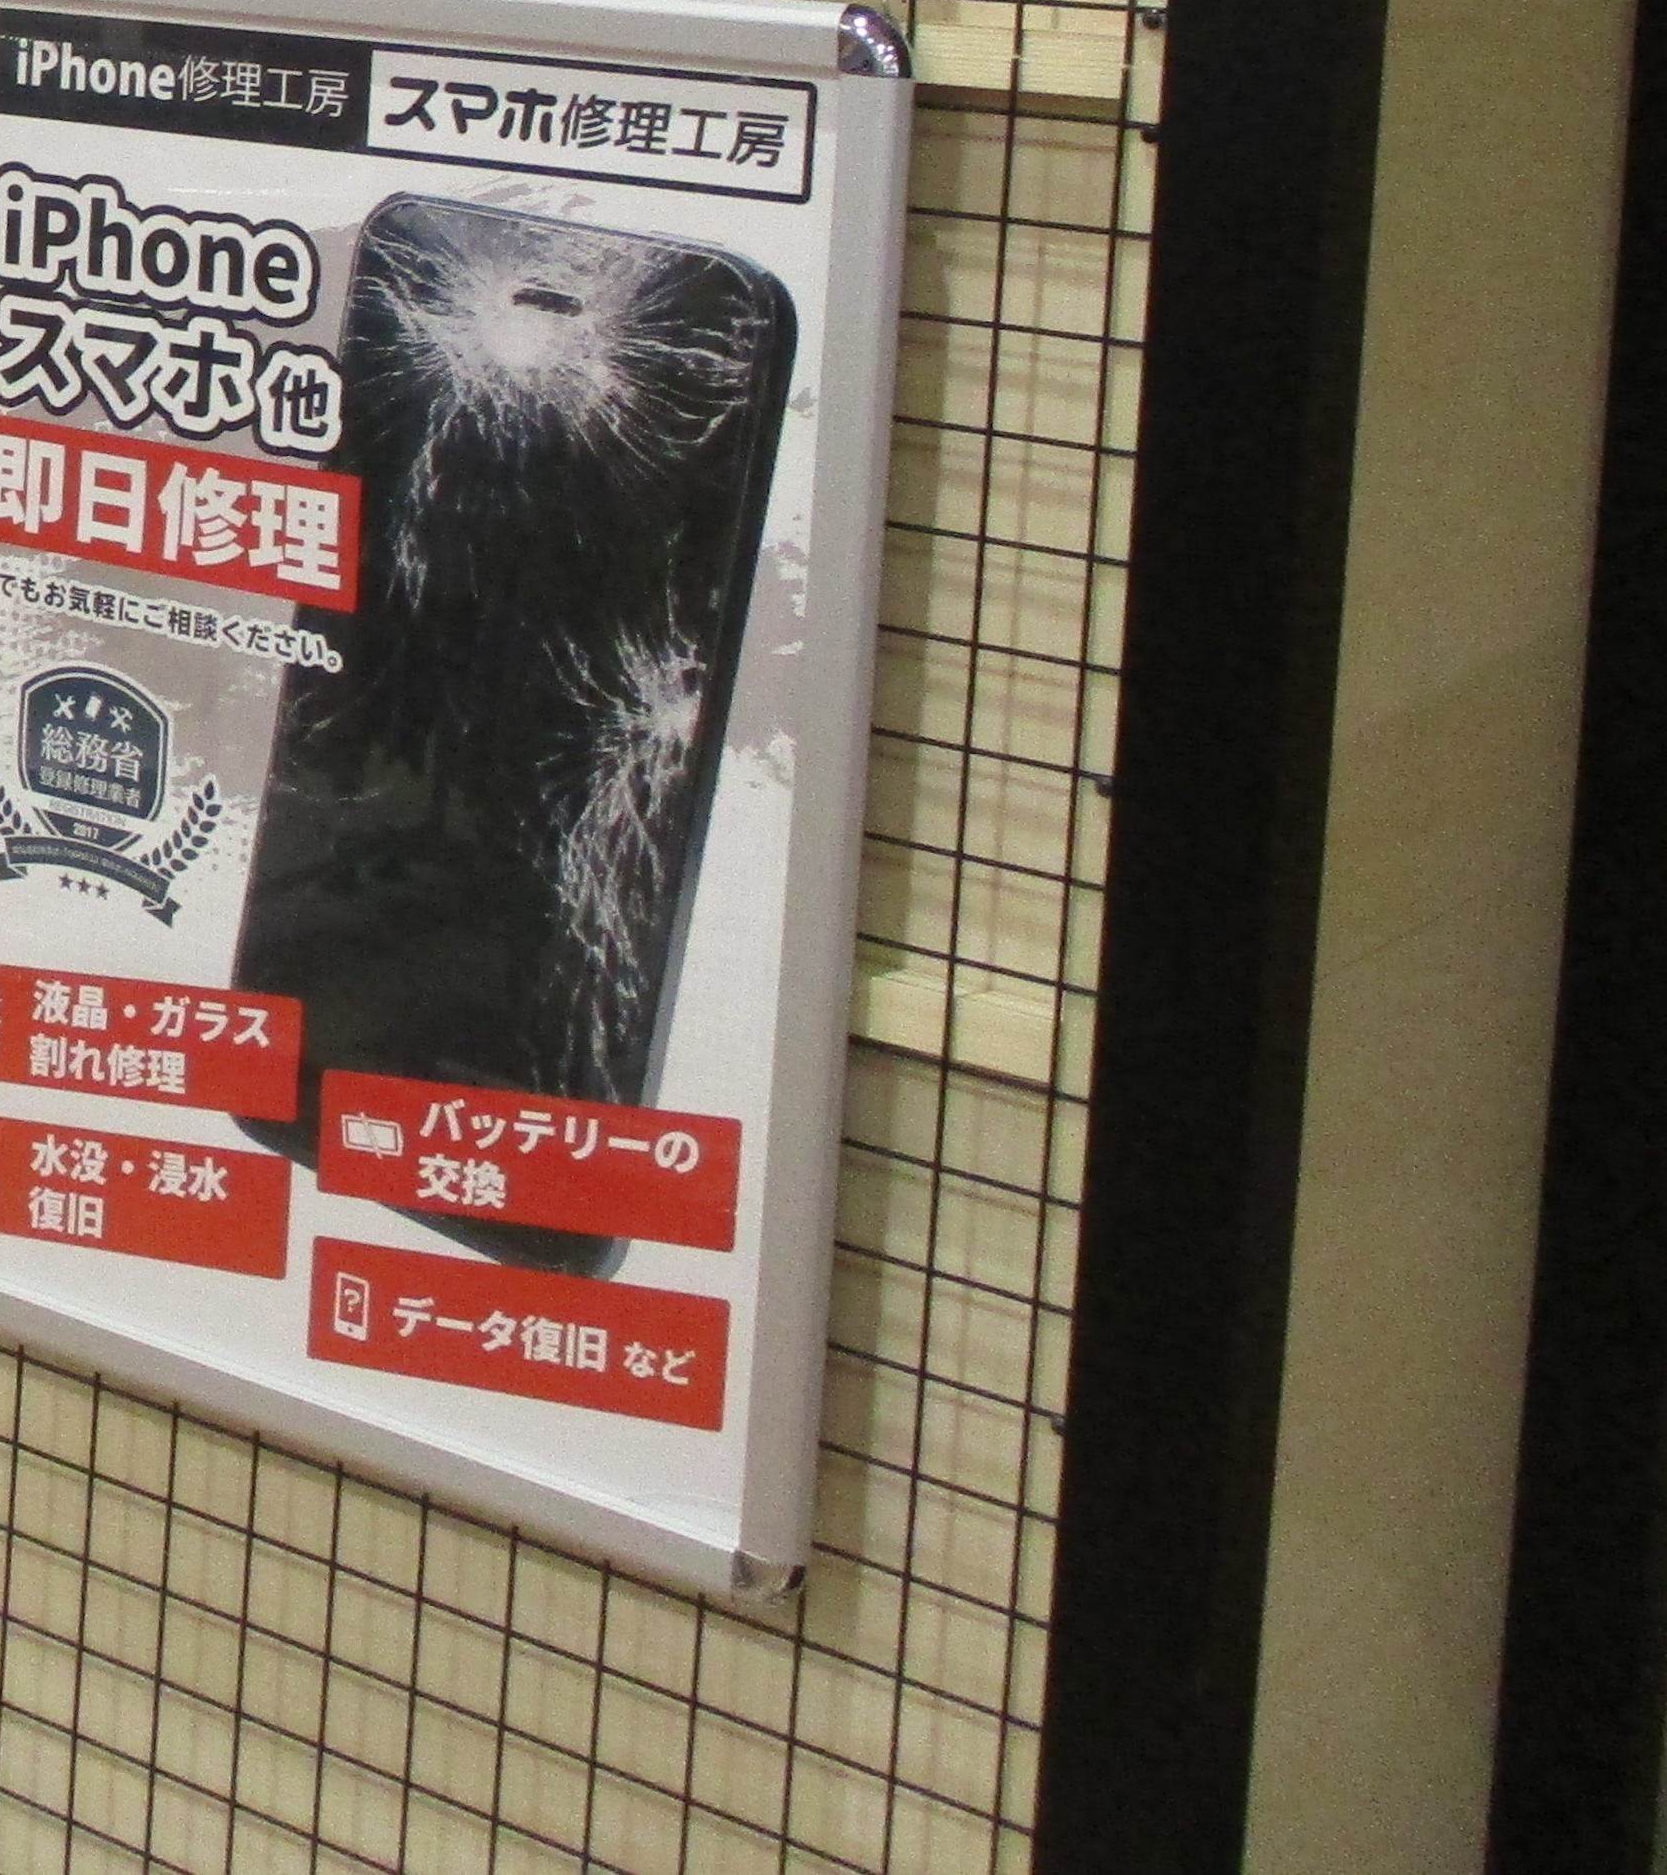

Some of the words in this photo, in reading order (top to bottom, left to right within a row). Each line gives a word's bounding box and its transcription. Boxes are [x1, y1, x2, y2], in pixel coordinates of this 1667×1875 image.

[14, 36, 352, 119] iPhone修理工房
[384, 73, 789, 170] スマホ修理工房
[40, 723, 144, 782] 総務省
[32, 979, 272, 1050] 液晶・ガラス
[29, 1034, 188, 1095] 割れ修理
[30, 1137, 229, 1203] 水没・浸水
[418, 1098, 701, 1175] バッテリーの
[27, 1186, 105, 1239] 復旧
[416, 1151, 508, 1211] 交換
[391, 1296, 607, 1373] データ復旧
[623, 1340, 697, 1387] など
